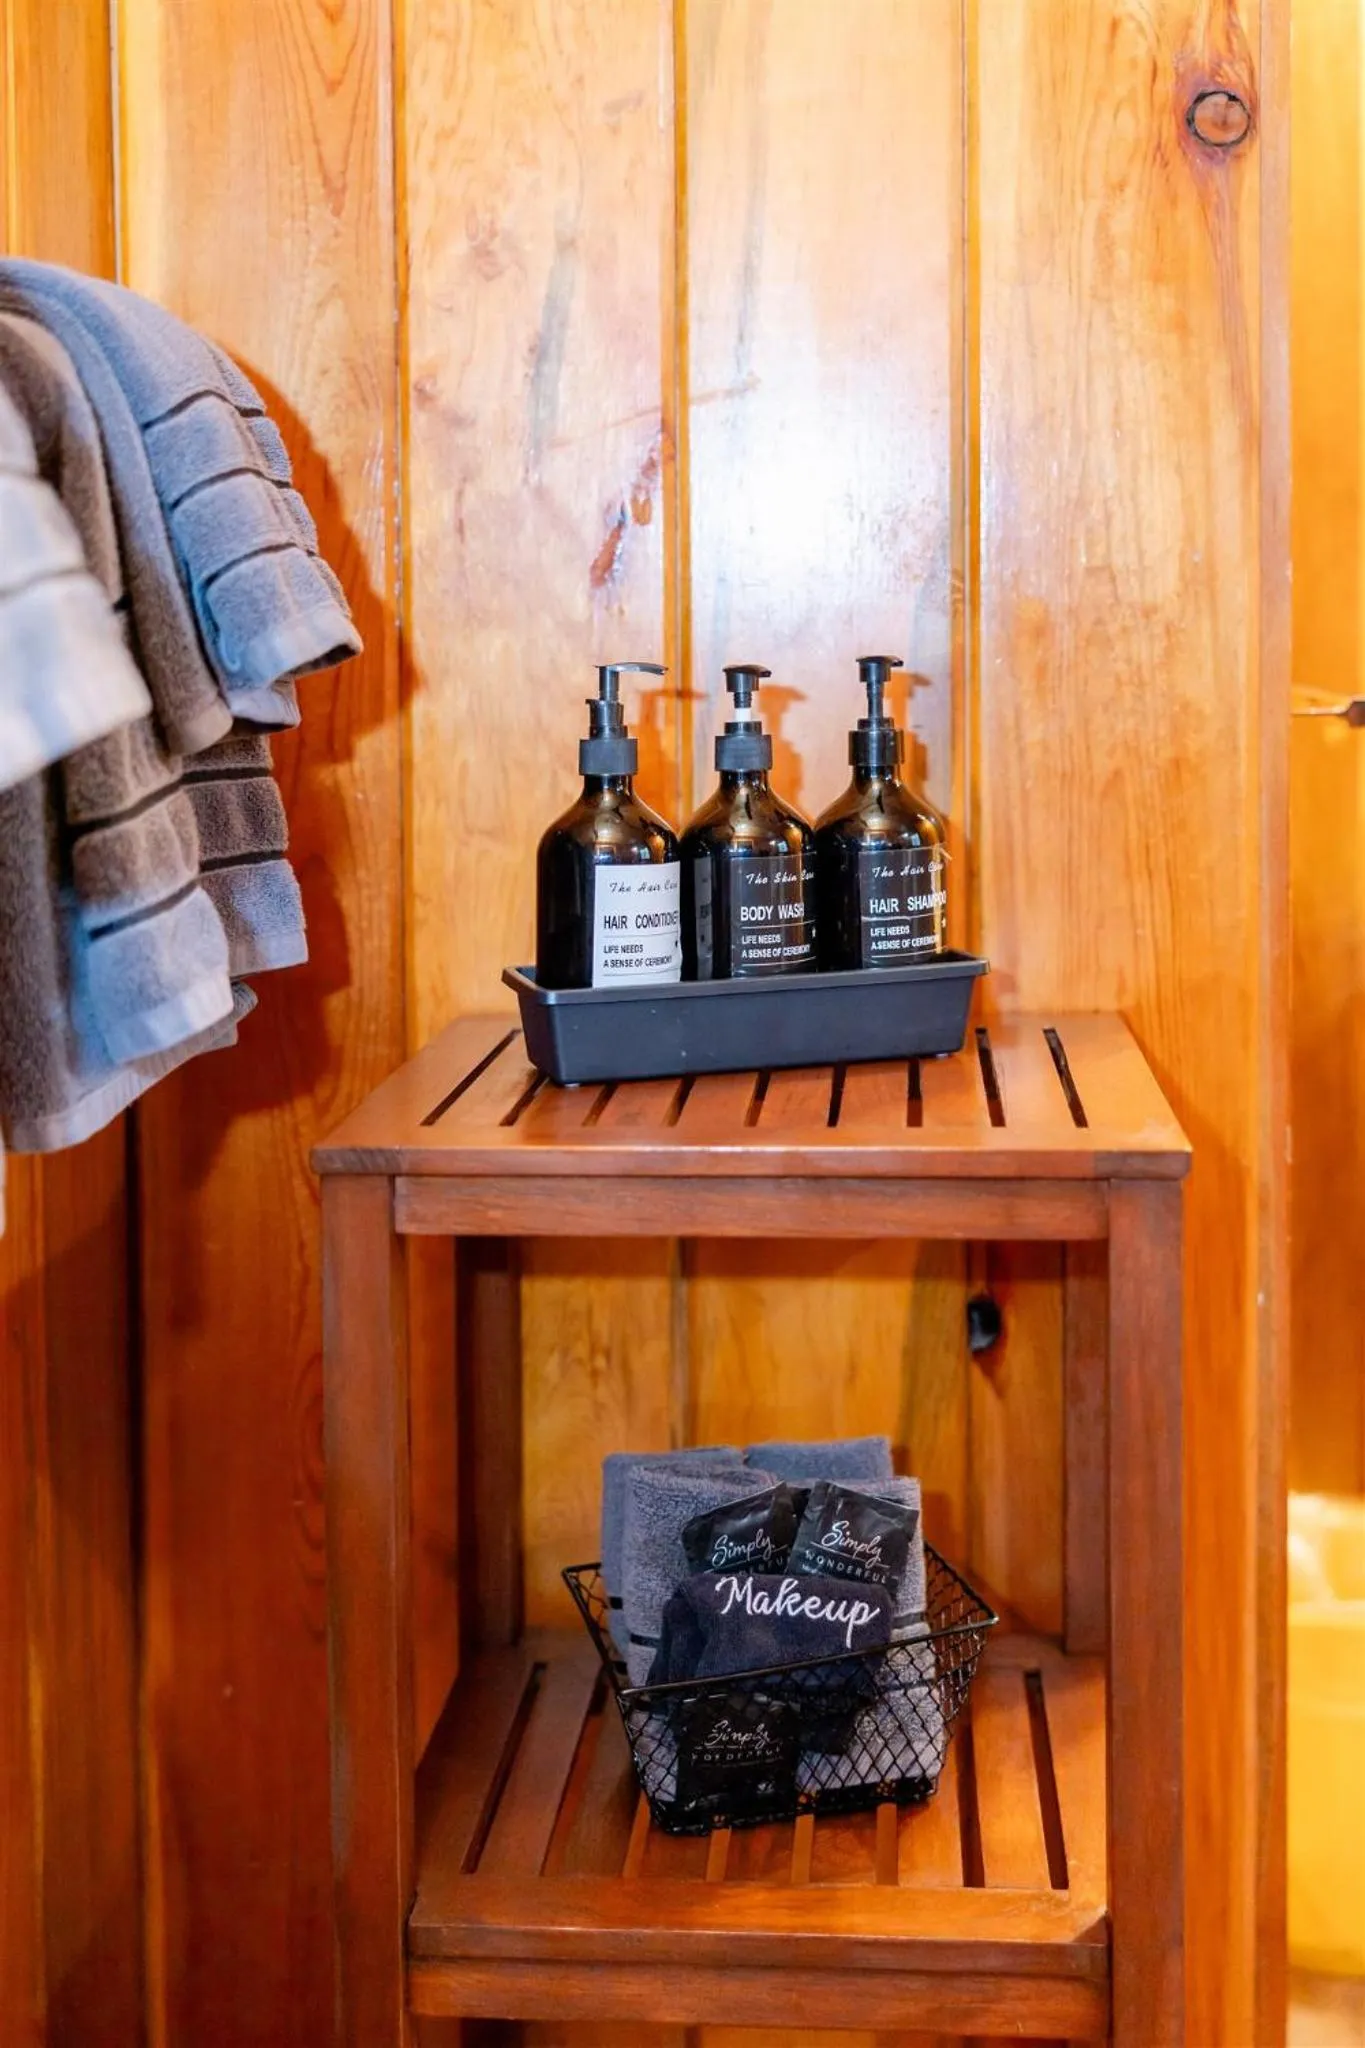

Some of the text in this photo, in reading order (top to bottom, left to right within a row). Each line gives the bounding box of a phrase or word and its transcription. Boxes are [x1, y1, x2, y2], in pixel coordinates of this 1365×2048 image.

[745, 872, 768, 884] The
[773, 871, 798, 883] Skin
[872, 866, 894, 878] The
[900, 864, 924, 876] Hair
[608, 882, 632, 893] The
[638, 881, 660, 893] Hair
[740, 902, 805, 921] BODY WASH
[869, 897, 899, 914] HAIR
[603, 910, 679, 929] HAIR CONDITIONE
[870, 925, 910, 937] LIFE NEEDS
[741, 934, 782, 945] LIFE NEEDS
[870, 942, 877, 950] A
[878, 940, 900, 950] SENSE
[901, 939, 910, 948] OF
[603, 944, 644, 954] LIFE NEEDS
[742, 950, 748, 958] A
[748, 949, 772, 958] SENSE
[772, 948, 781, 957] OF
[603, 960, 609, 968] A
[610, 959, 633, 968] SENSE
[634, 958, 643, 968] OF
[711, 1528, 773, 1567] Simply
[821, 1520, 883, 1569] Simply
[804, 1548, 887, 1585] WONDERFUL
[714, 1576, 881, 1649] Makeup
